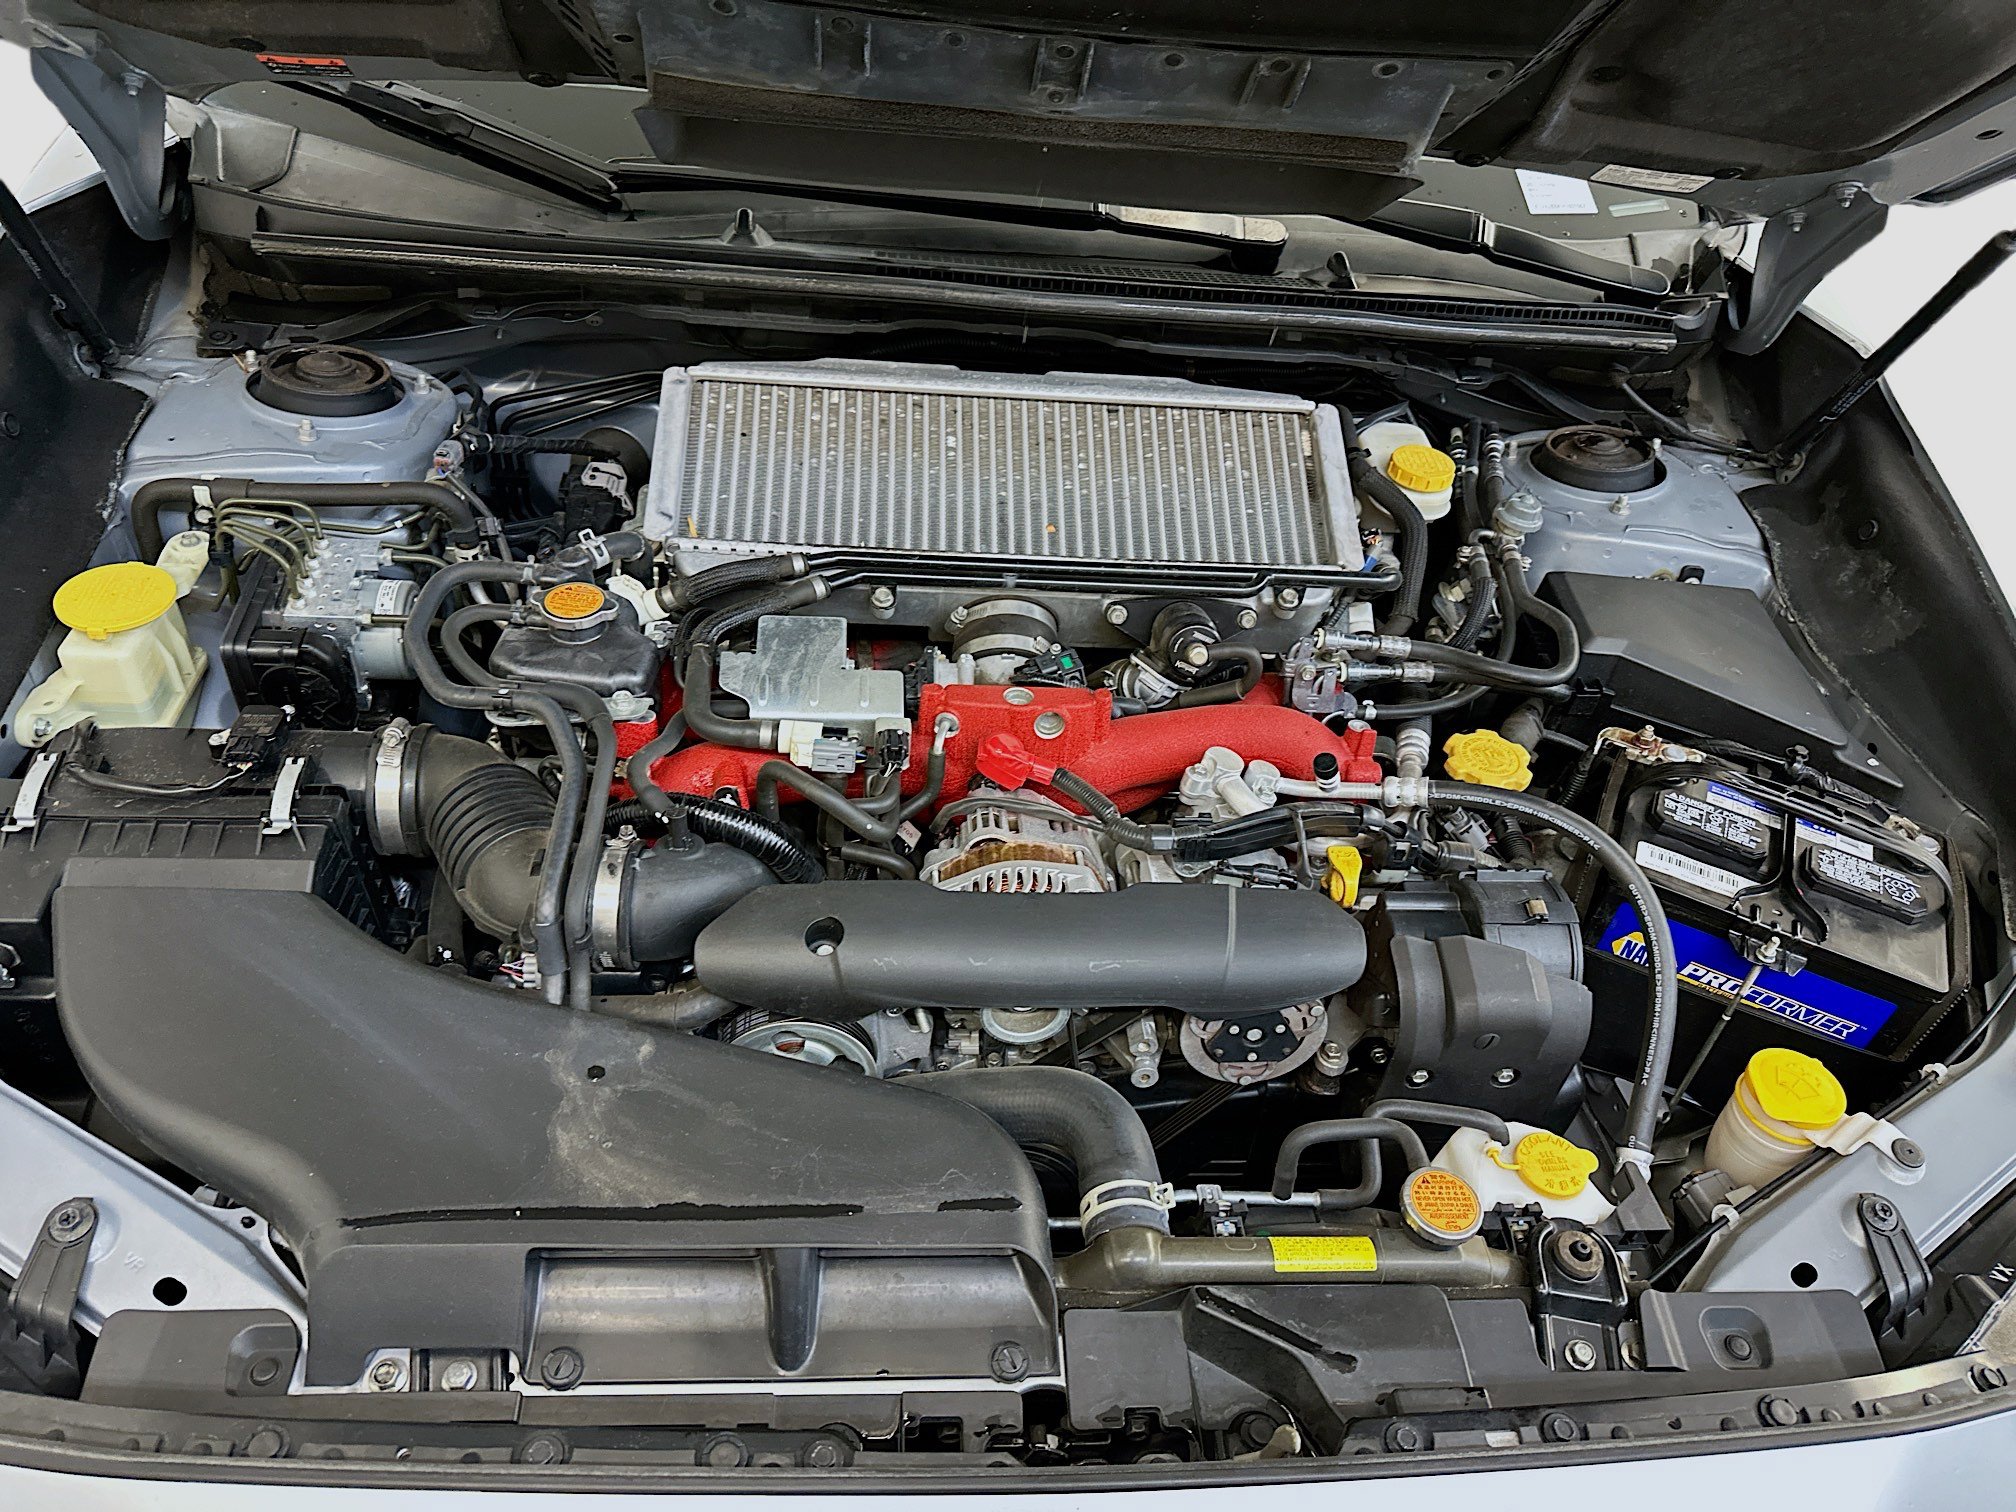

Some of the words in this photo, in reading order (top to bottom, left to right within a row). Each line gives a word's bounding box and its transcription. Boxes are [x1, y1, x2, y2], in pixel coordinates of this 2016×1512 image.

[1520, 1134, 1574, 1156] COOLANT
[1539, 1150, 1555, 1159] SEE
[1540, 1164, 1571, 1173] MANUAL
